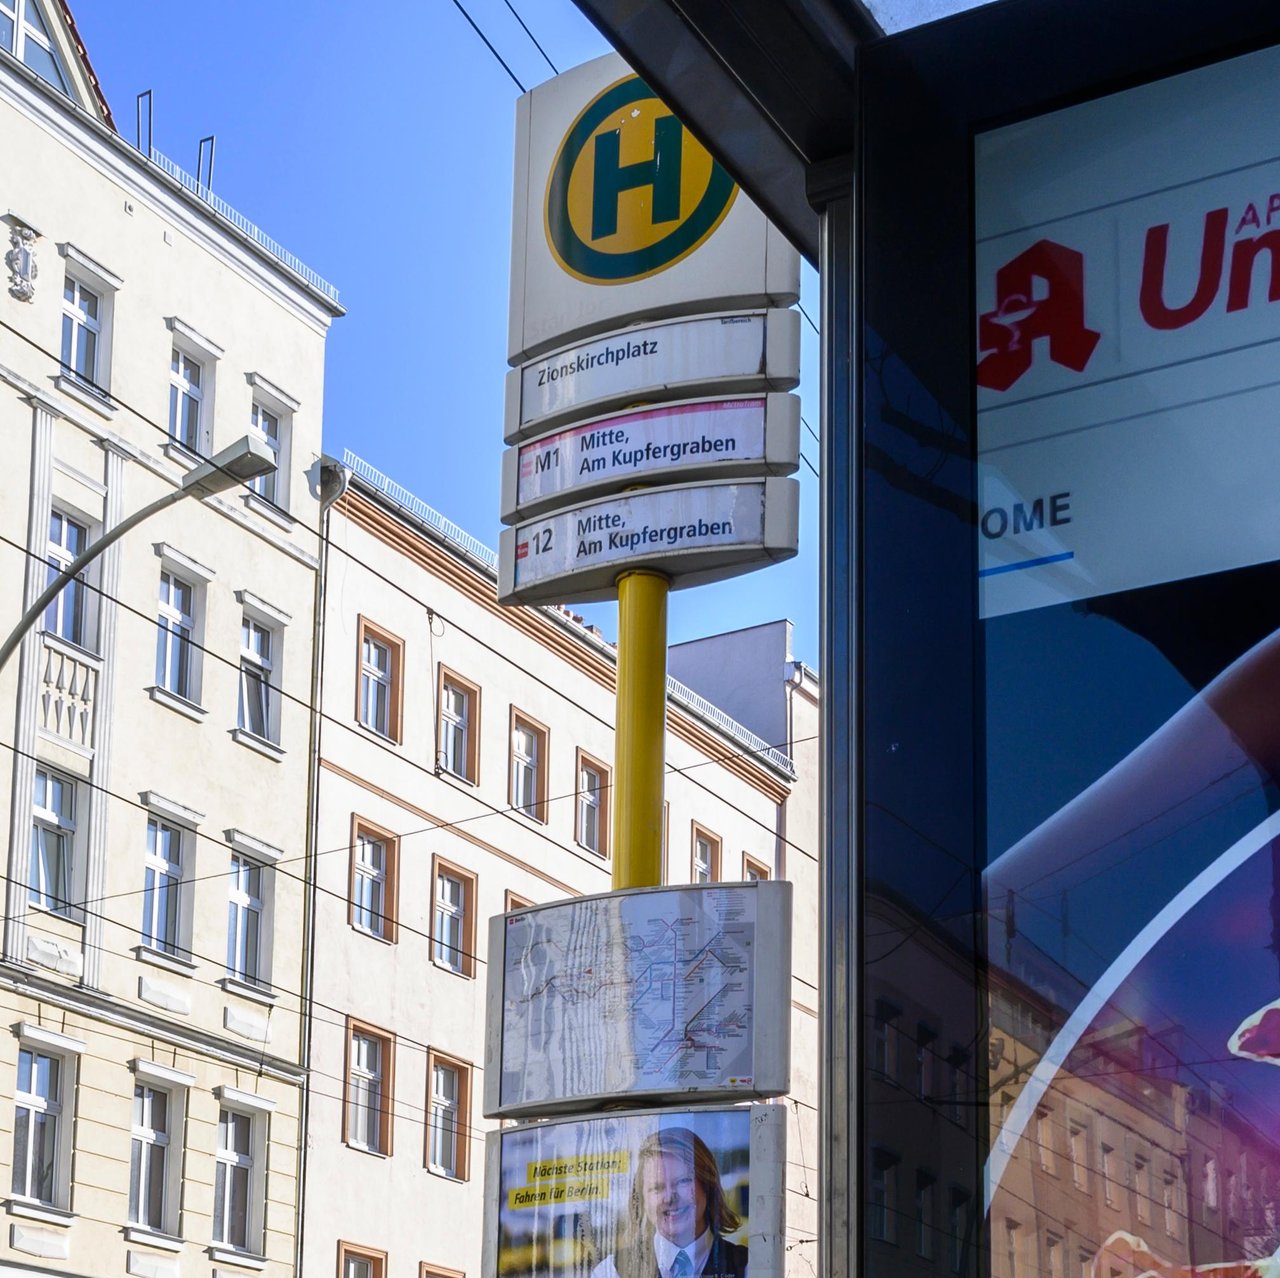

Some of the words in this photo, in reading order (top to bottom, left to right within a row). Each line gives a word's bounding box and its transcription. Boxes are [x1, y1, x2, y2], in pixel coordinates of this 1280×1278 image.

[591, 114, 683, 241] H
[537, 338, 658, 387] Zionskirchplatz
[580, 428, 630, 452] Mitte,
[535, 447, 560, 474] M1
[579, 456, 608, 475] Am
[611, 435, 737, 470] Kupfergraben
[577, 511, 626, 536] Mitte,
[981, 492, 1072, 540] OME
[533, 528, 553, 555] 12
[576, 539, 605, 558] Am
[608, 518, 733, 552] Kupfergraben
[533, 1164, 574, 1178] Nächste
[514, 1190, 546, 1204] Fahren
[549, 1187, 564, 1200] für
